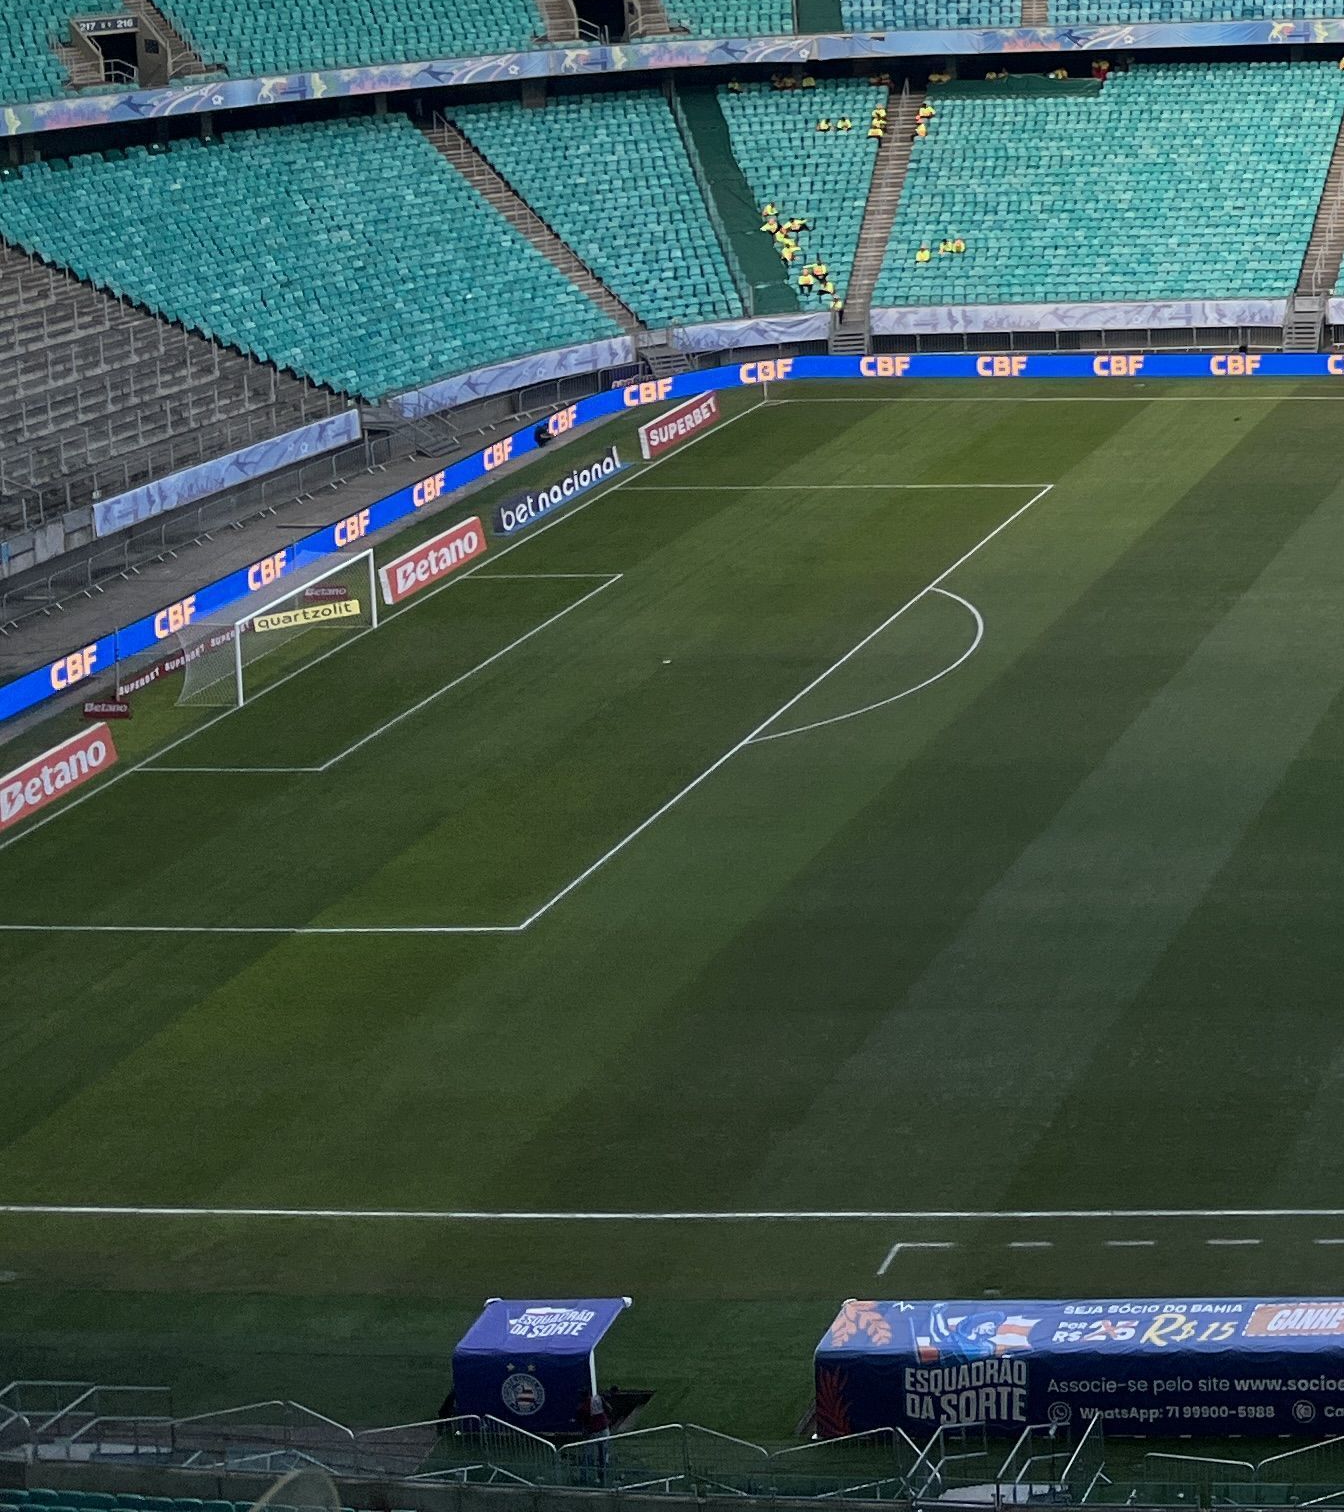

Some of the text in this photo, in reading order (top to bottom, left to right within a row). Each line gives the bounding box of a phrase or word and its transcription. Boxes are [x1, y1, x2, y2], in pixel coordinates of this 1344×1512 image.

[80, 22, 96, 32] 217
[739, 358, 793, 384] CBF
[860, 356, 909, 377] CBF
[977, 356, 1027, 377] CBF
[1093, 355, 1144, 377] CBF
[1210, 355, 1261, 376] CBF
[624, 377, 672, 407] CBF
[548, 405, 577, 437] CBF
[649, 395, 718, 448] SUPERBET
[483, 437, 513, 471] CBF
[412, 470, 445, 508] CBF
[334, 508, 370, 548] CBF
[248, 550, 286, 591] CBF
[396, 530, 479, 594] Betano
[154, 594, 196, 639] CBF
[257, 600, 353, 630] quartzolit
[50, 644, 97, 690] CBF
[119, 666, 161, 696] SUPERBET
[84, 702, 129, 714] Betano
[0, 739, 108, 822] Betano
[1064, 1301, 1243, 1316] SEJA SÓCIO DO BAHIA
[509, 1321, 589, 1339] DA SORTE
[1052, 1320, 1139, 1343] R$ 25
[1058, 1319, 1087, 1331] POR
[1140, 1313, 1237, 1346] R$ 15
[904, 1354, 1027, 1396] ESQUADRÃO
[1047, 1377, 1231, 1396] Associe-se pelo site
[905, 1387, 1027, 1425] DA SORTE
[1080, 1405, 1164, 1421] WhatsApp:
[1166, 1406, 1179, 1419] 71
